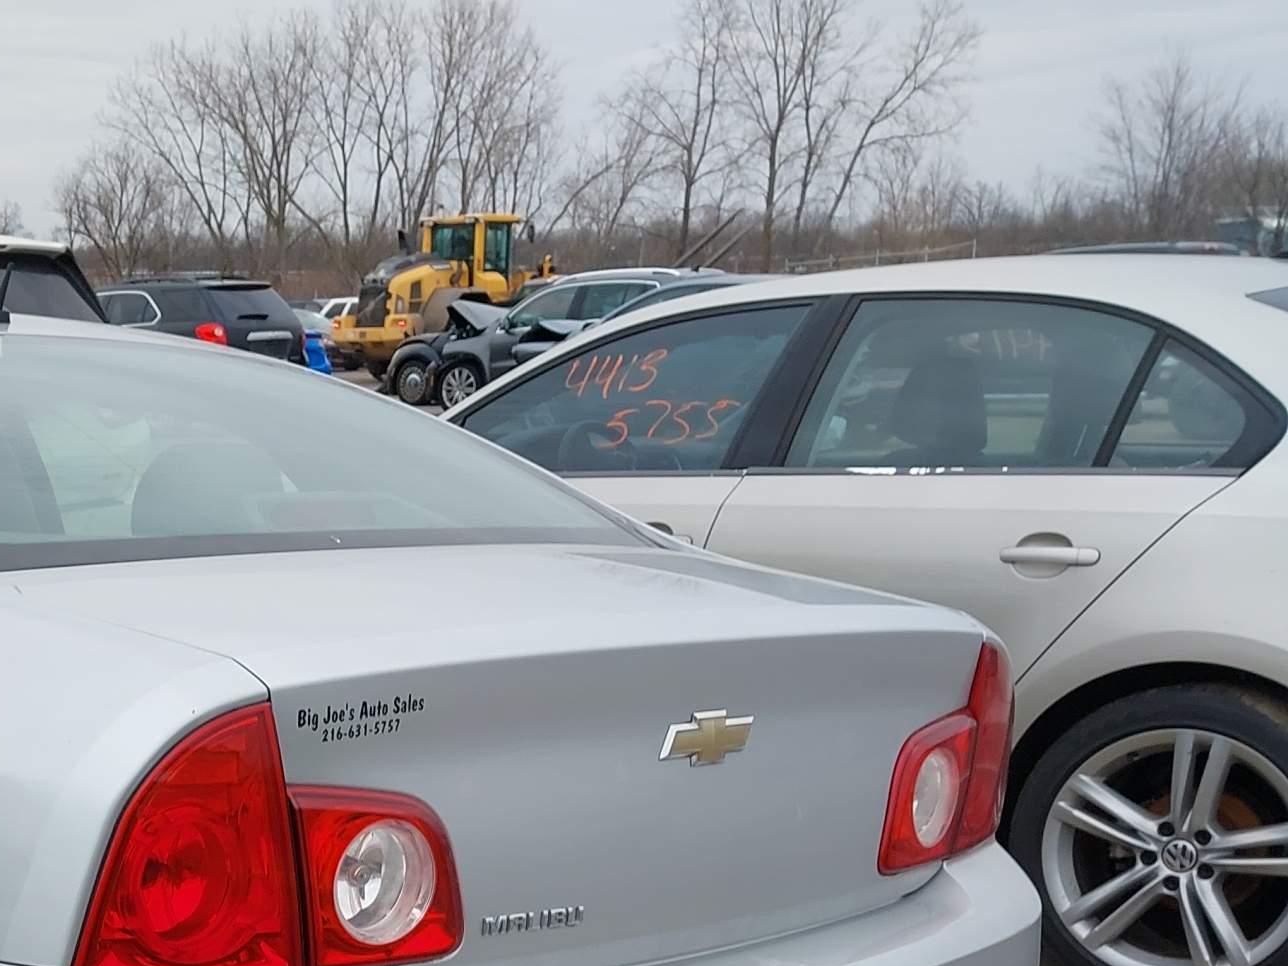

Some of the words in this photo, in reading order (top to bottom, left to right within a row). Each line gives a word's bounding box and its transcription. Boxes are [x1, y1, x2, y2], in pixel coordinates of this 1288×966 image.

[566, 349, 668, 399] 4413
[297, 708, 319, 731] Big
[323, 702, 355, 725] Joe's
[359, 700, 389, 720] Auto
[393, 693, 425, 714] Sales
[322, 718, 401, 743] 216-631-5757
[481, 905, 584, 936] MALIBU
